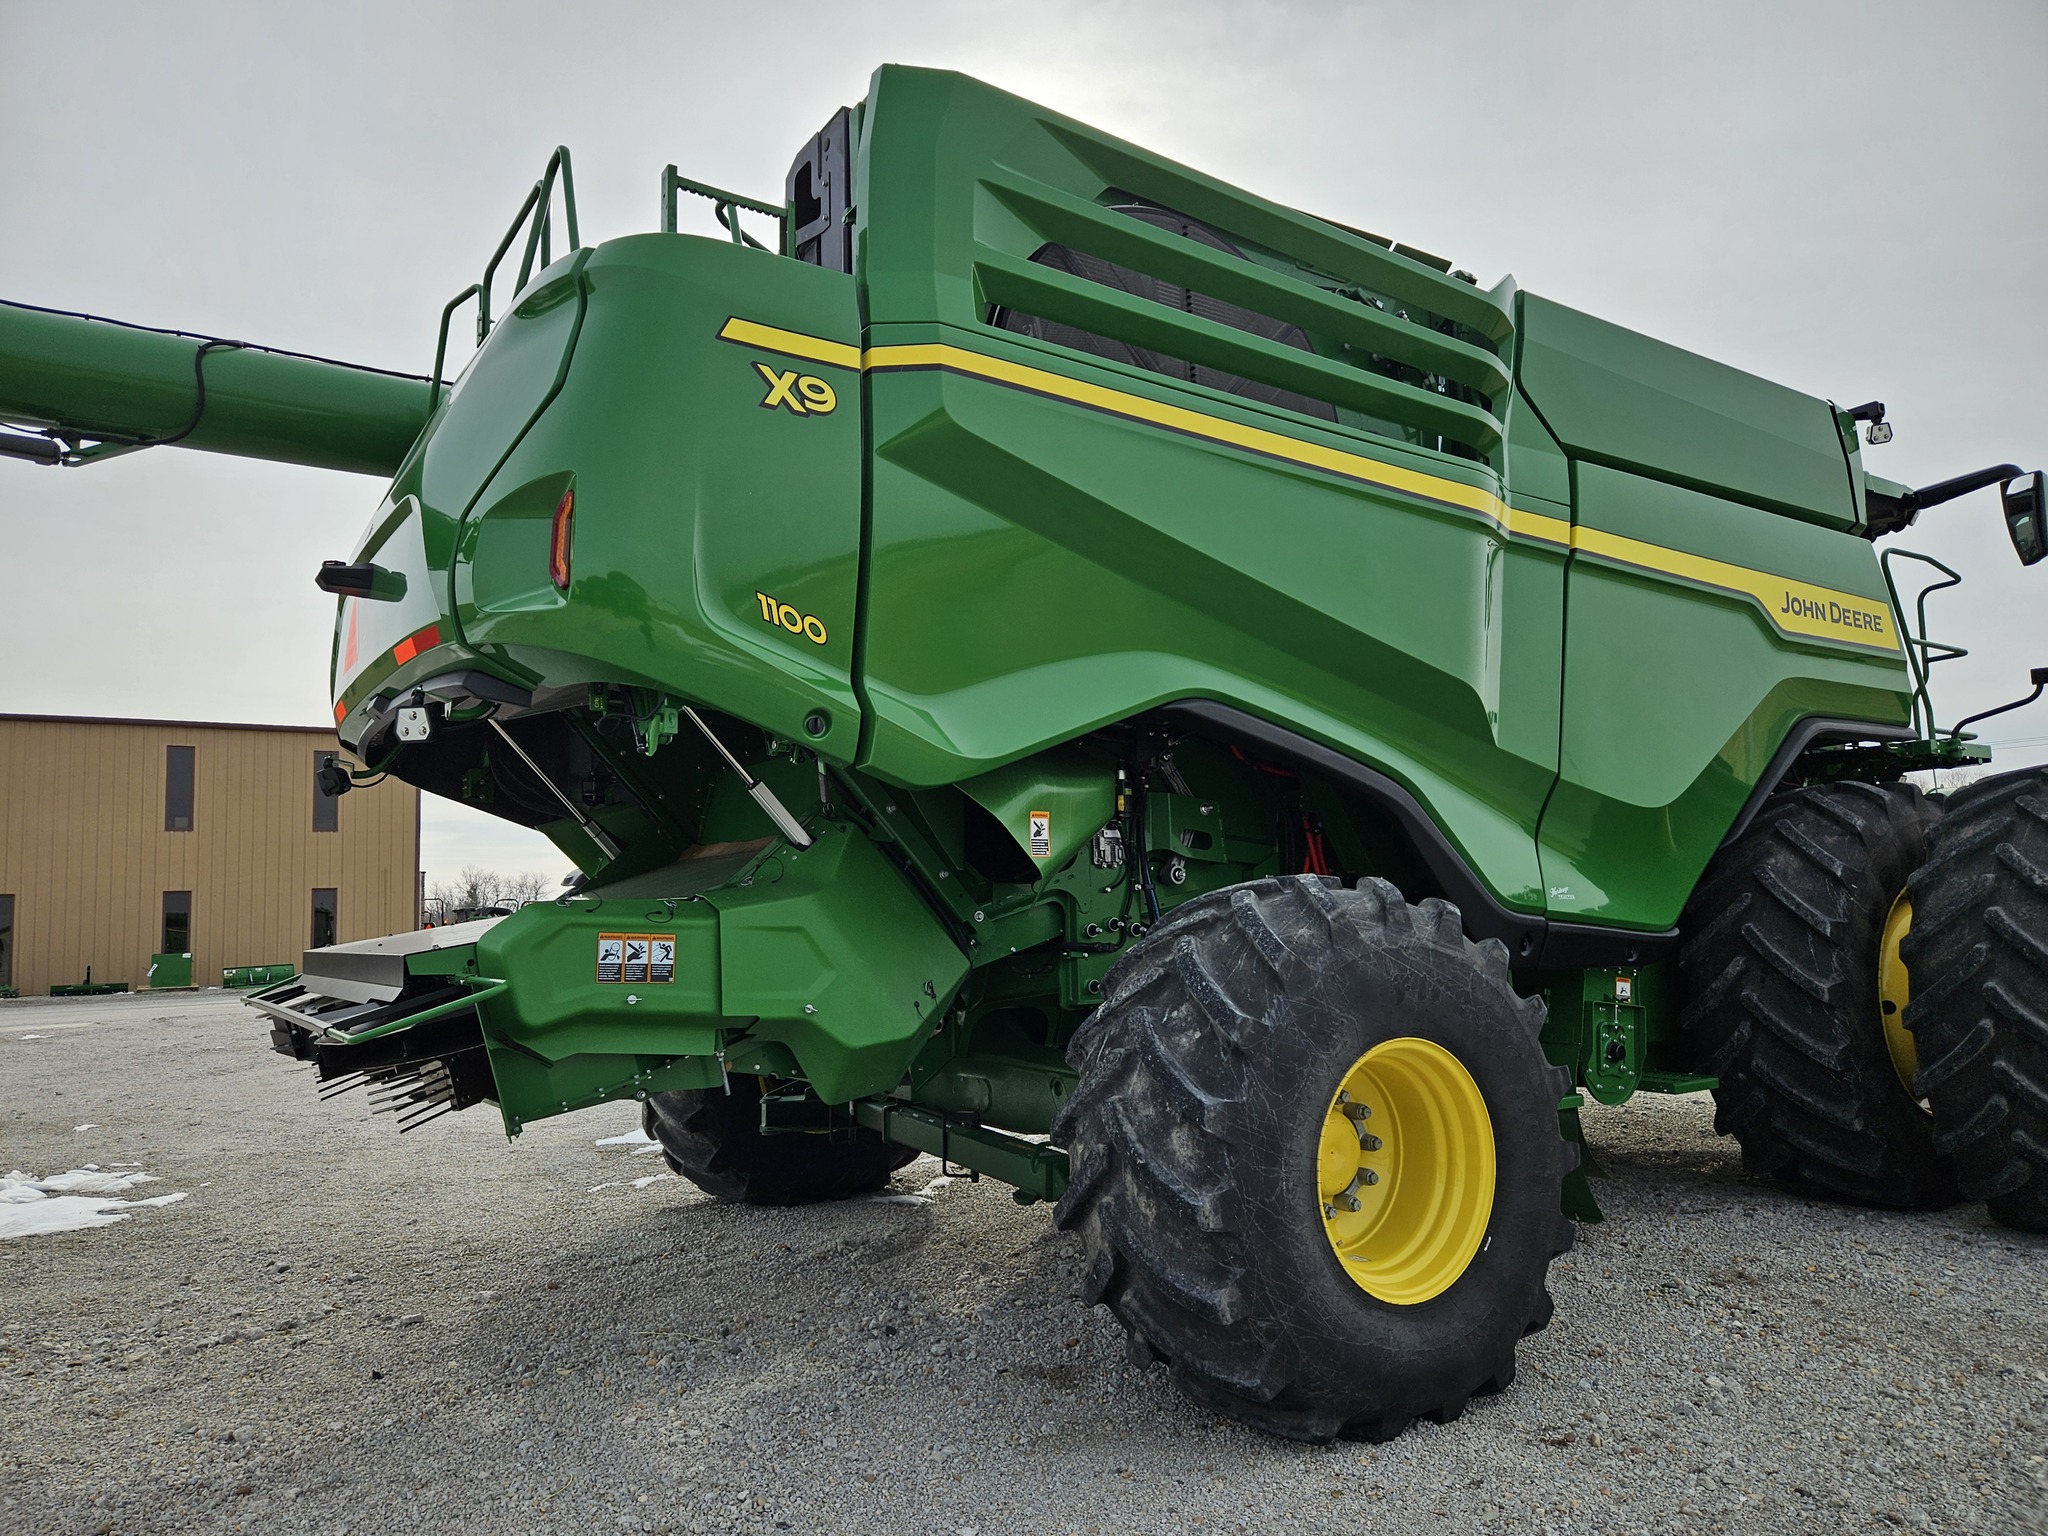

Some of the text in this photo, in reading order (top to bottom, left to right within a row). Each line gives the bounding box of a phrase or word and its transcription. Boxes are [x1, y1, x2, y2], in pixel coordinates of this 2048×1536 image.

[751, 361, 837, 418] X9
[755, 590, 828, 646] 1100
[1781, 591, 1884, 633] JOHN DEERE
